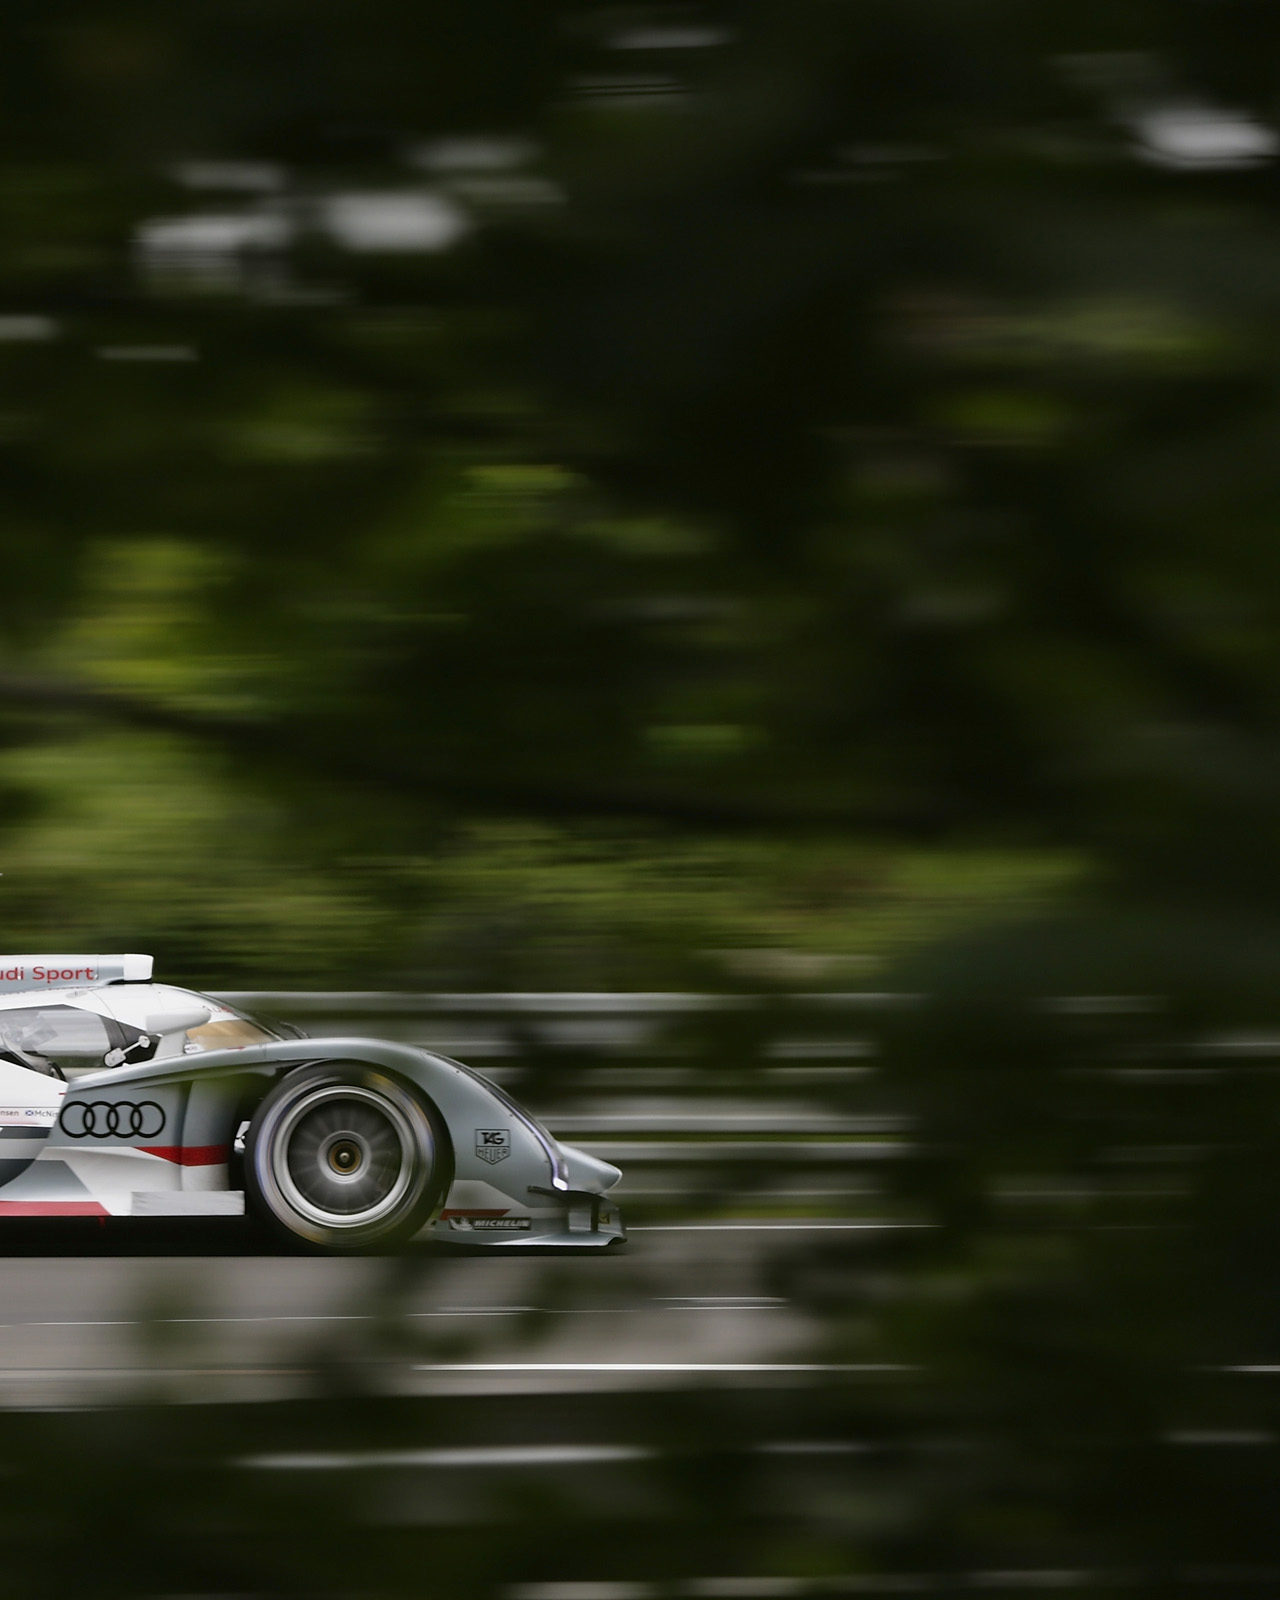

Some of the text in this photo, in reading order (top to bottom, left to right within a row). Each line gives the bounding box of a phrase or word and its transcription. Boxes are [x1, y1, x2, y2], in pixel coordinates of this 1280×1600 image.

[32, 967, 94, 983] Sport
[481, 1132, 504, 1145] TAG
[478, 1148, 508, 1162] HEUER
[474, 1219, 530, 1228] MICHELIN
